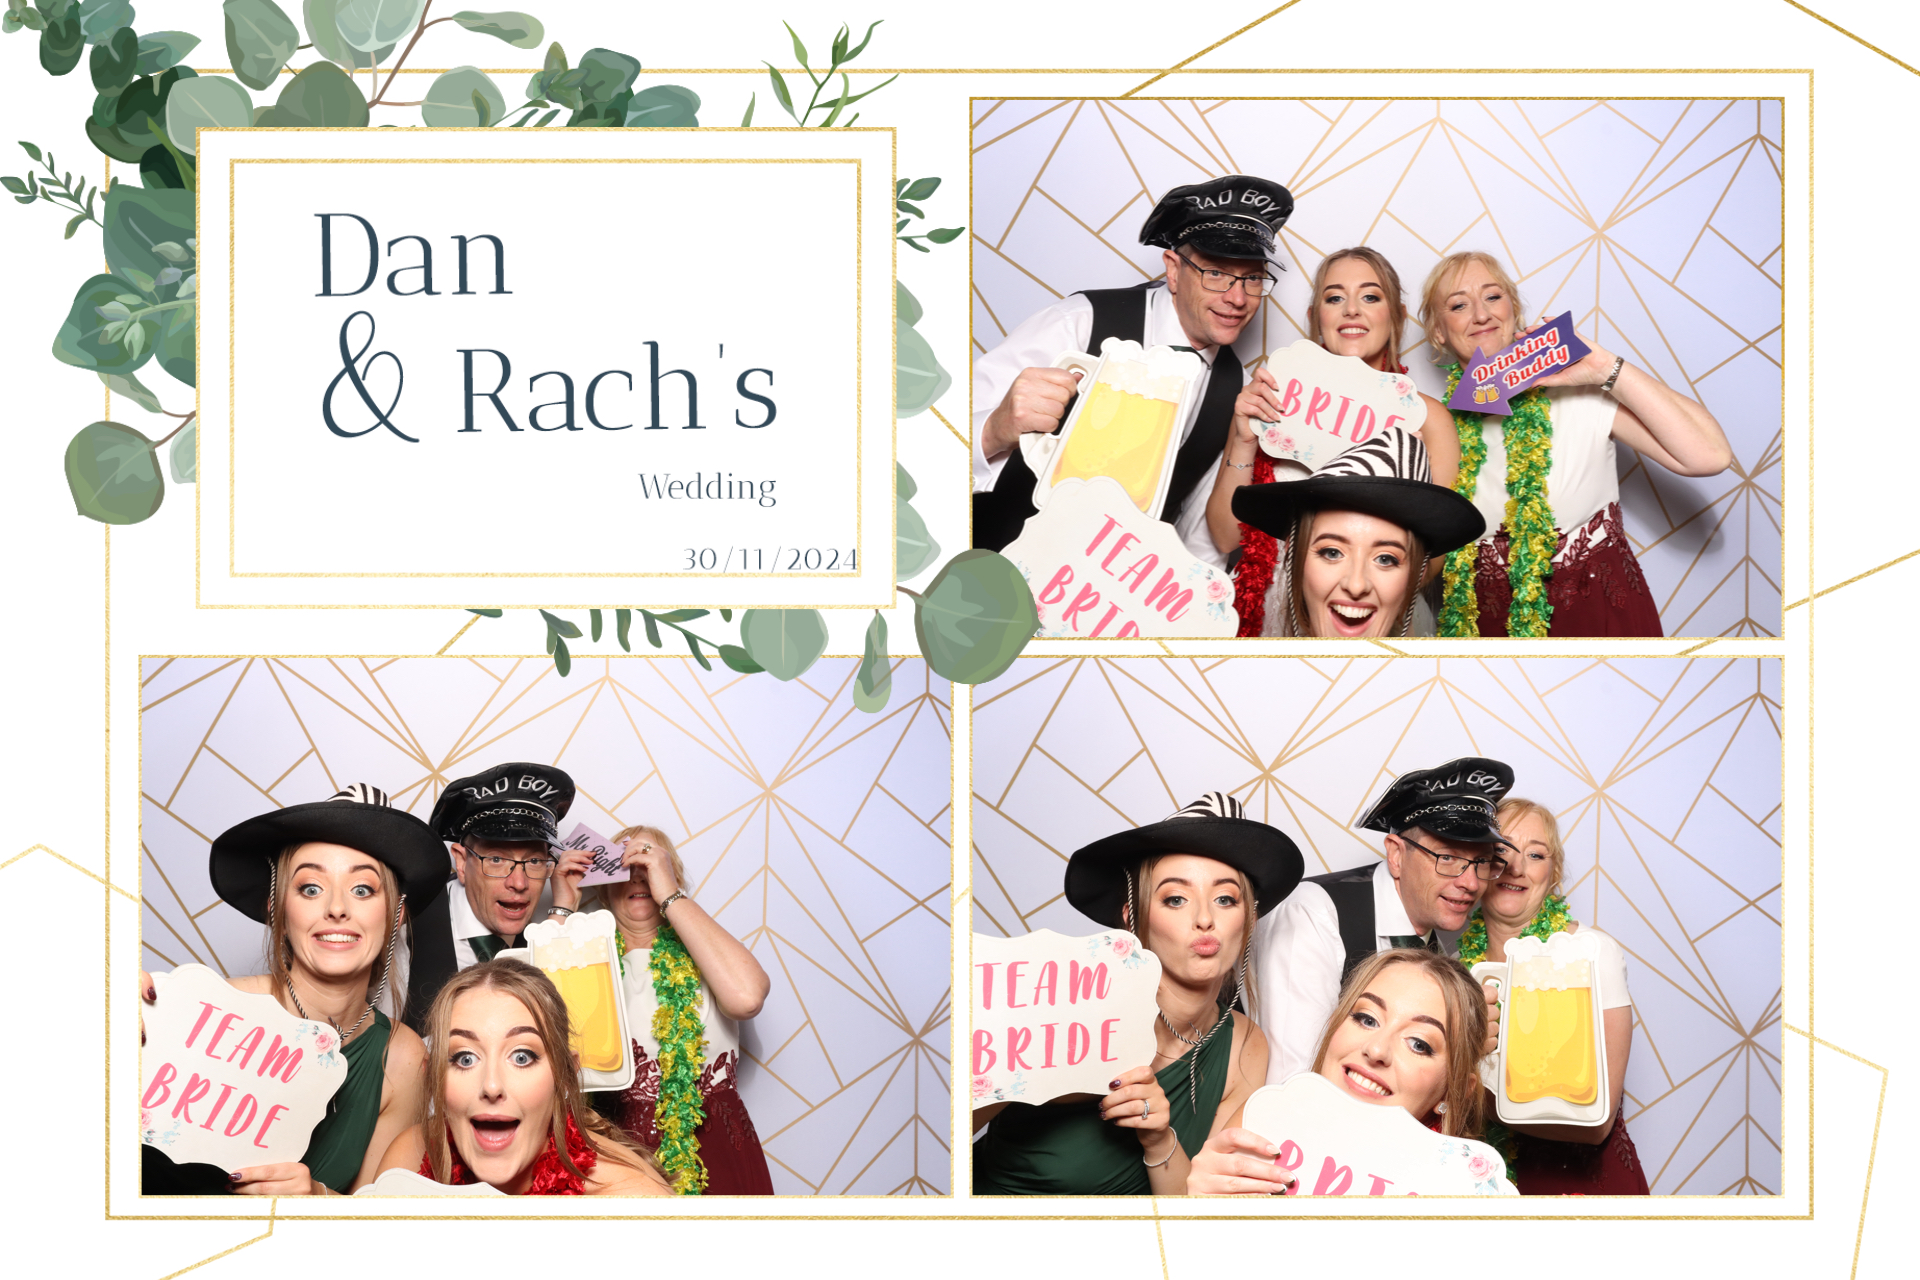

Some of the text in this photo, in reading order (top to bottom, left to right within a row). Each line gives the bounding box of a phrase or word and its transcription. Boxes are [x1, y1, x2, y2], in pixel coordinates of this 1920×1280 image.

[1240, 188, 1282, 215] BOY
[1472, 327, 1558, 383] Drinking
[1503, 346, 1569, 388] Buddy
[1085, 513, 1194, 623] TEAM
[517, 774, 560, 800] BOY
[1466, 769, 1506, 794] BOY
[589, 844, 625, 877] Right
[974, 959, 1112, 1011] TEAM
[185, 1001, 304, 1084] TEAM
[972, 1018, 1121, 1076] BRIDE
[141, 1062, 290, 1149] BRIDE
